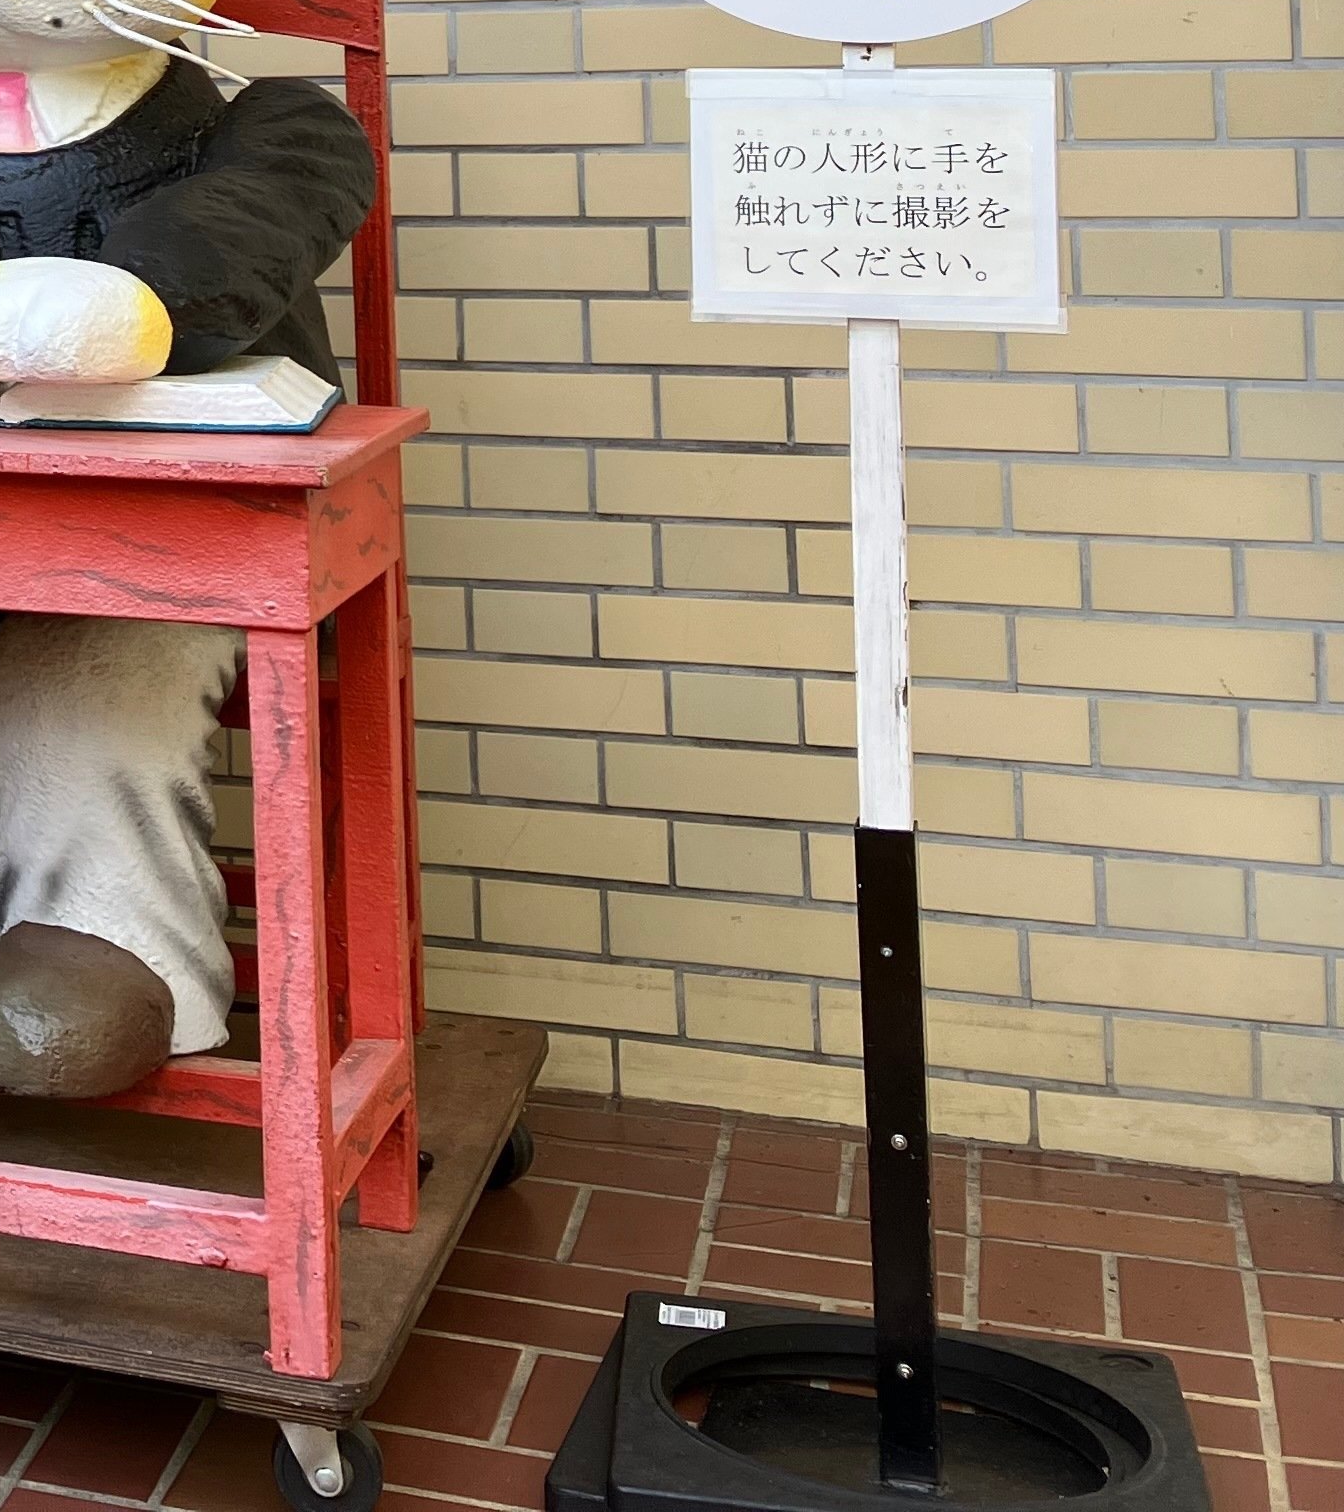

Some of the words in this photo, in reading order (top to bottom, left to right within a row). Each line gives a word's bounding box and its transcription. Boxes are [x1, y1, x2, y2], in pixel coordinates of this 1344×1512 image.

[733, 141, 1009, 174] 猫の人形に手を
[734, 194, 1011, 230] 触れずに撮影を
[743, 245, 988, 282] してください。
